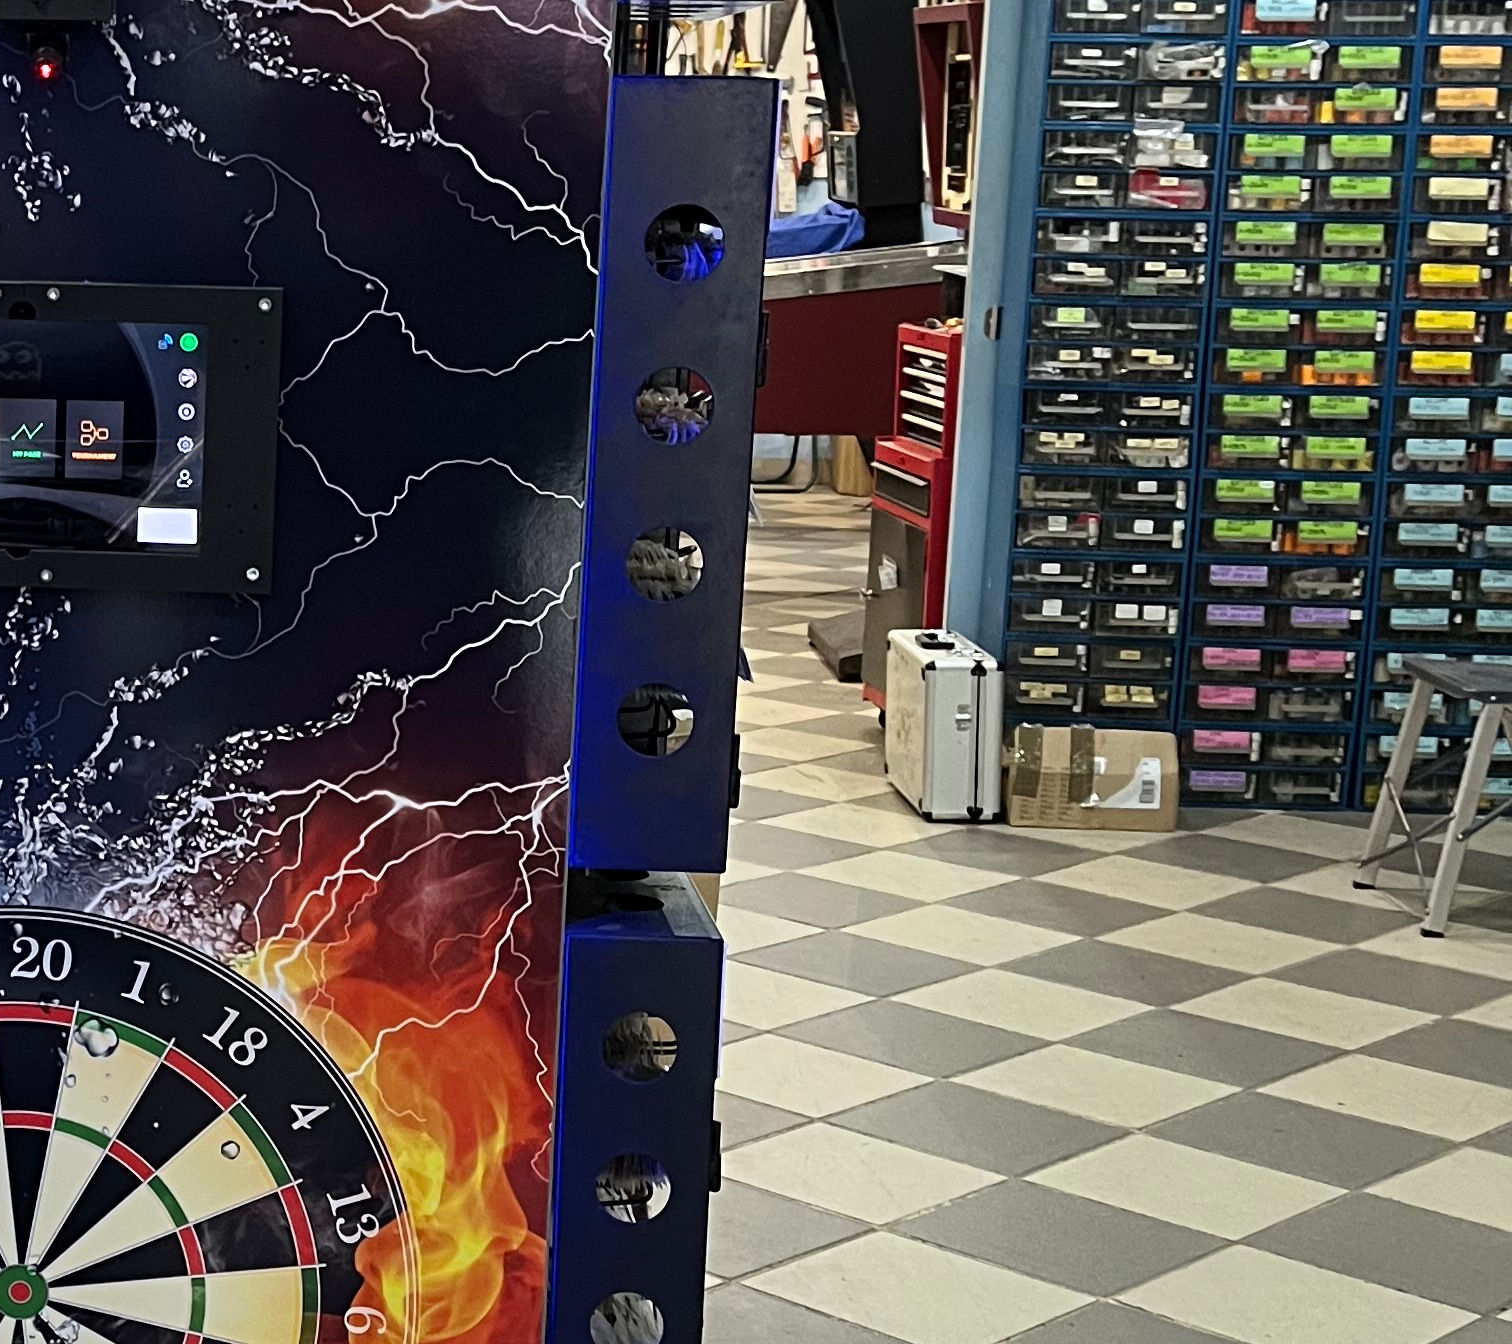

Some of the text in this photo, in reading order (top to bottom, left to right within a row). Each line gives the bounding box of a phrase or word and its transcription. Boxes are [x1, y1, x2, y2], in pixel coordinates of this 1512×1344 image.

[10, 936, 72, 981] 20
[121, 960, 151, 1004] 1
[202, 1006, 268, 1066] 18
[290, 1102, 330, 1131] 4
[326, 1183, 380, 1244] 13
